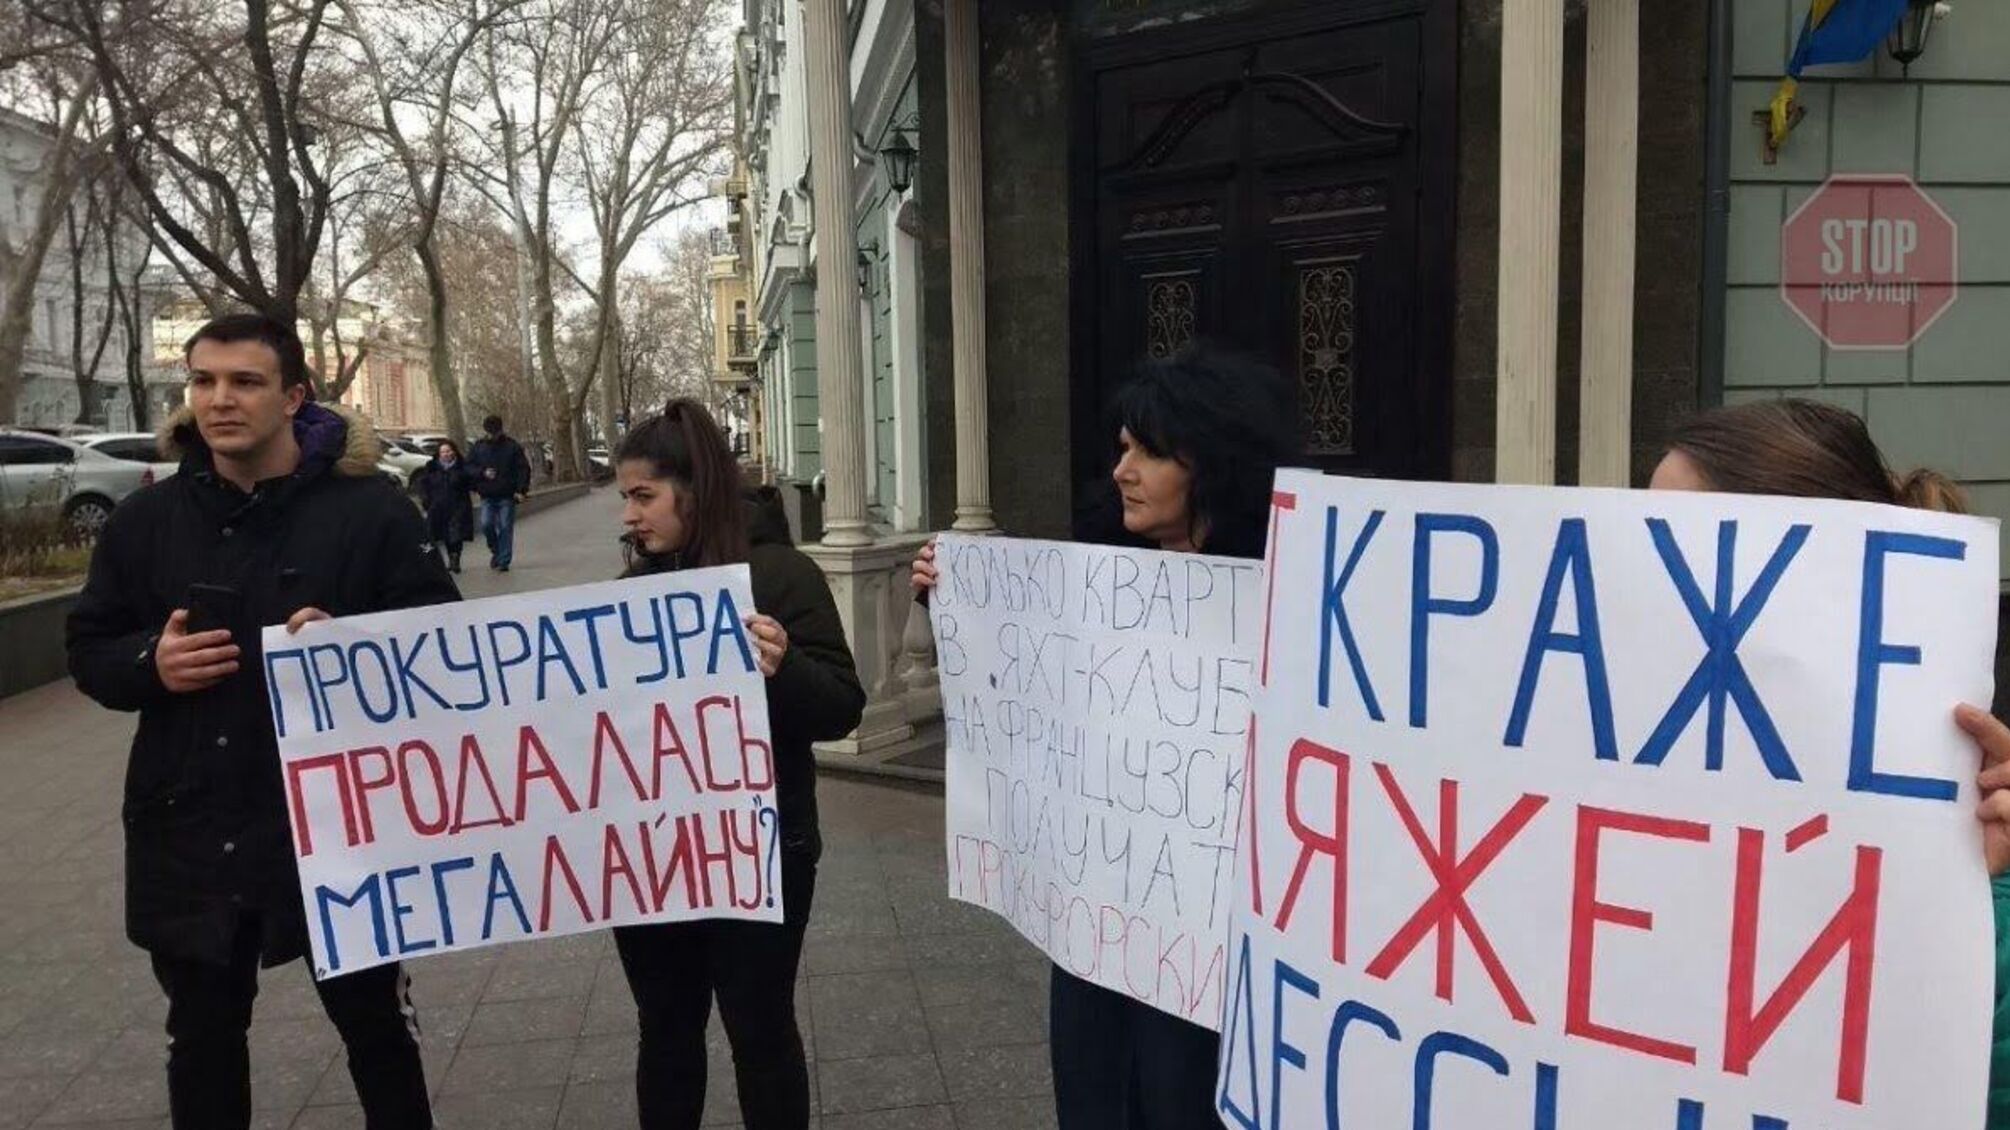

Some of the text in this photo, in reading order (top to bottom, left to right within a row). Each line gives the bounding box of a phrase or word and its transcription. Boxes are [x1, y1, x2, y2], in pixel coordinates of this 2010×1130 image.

[265, 587, 757, 738] ПРОКУРАТУРА
[939, 613, 967, 676] В
[1082, 553, 1264, 645] КВАРТ
[1317, 505, 1966, 802] КРАЖЕ
[286, 694, 775, 857] ПРОДАЛАСЬ
[985, 766, 1237, 930] ПОЛУЧАТ
